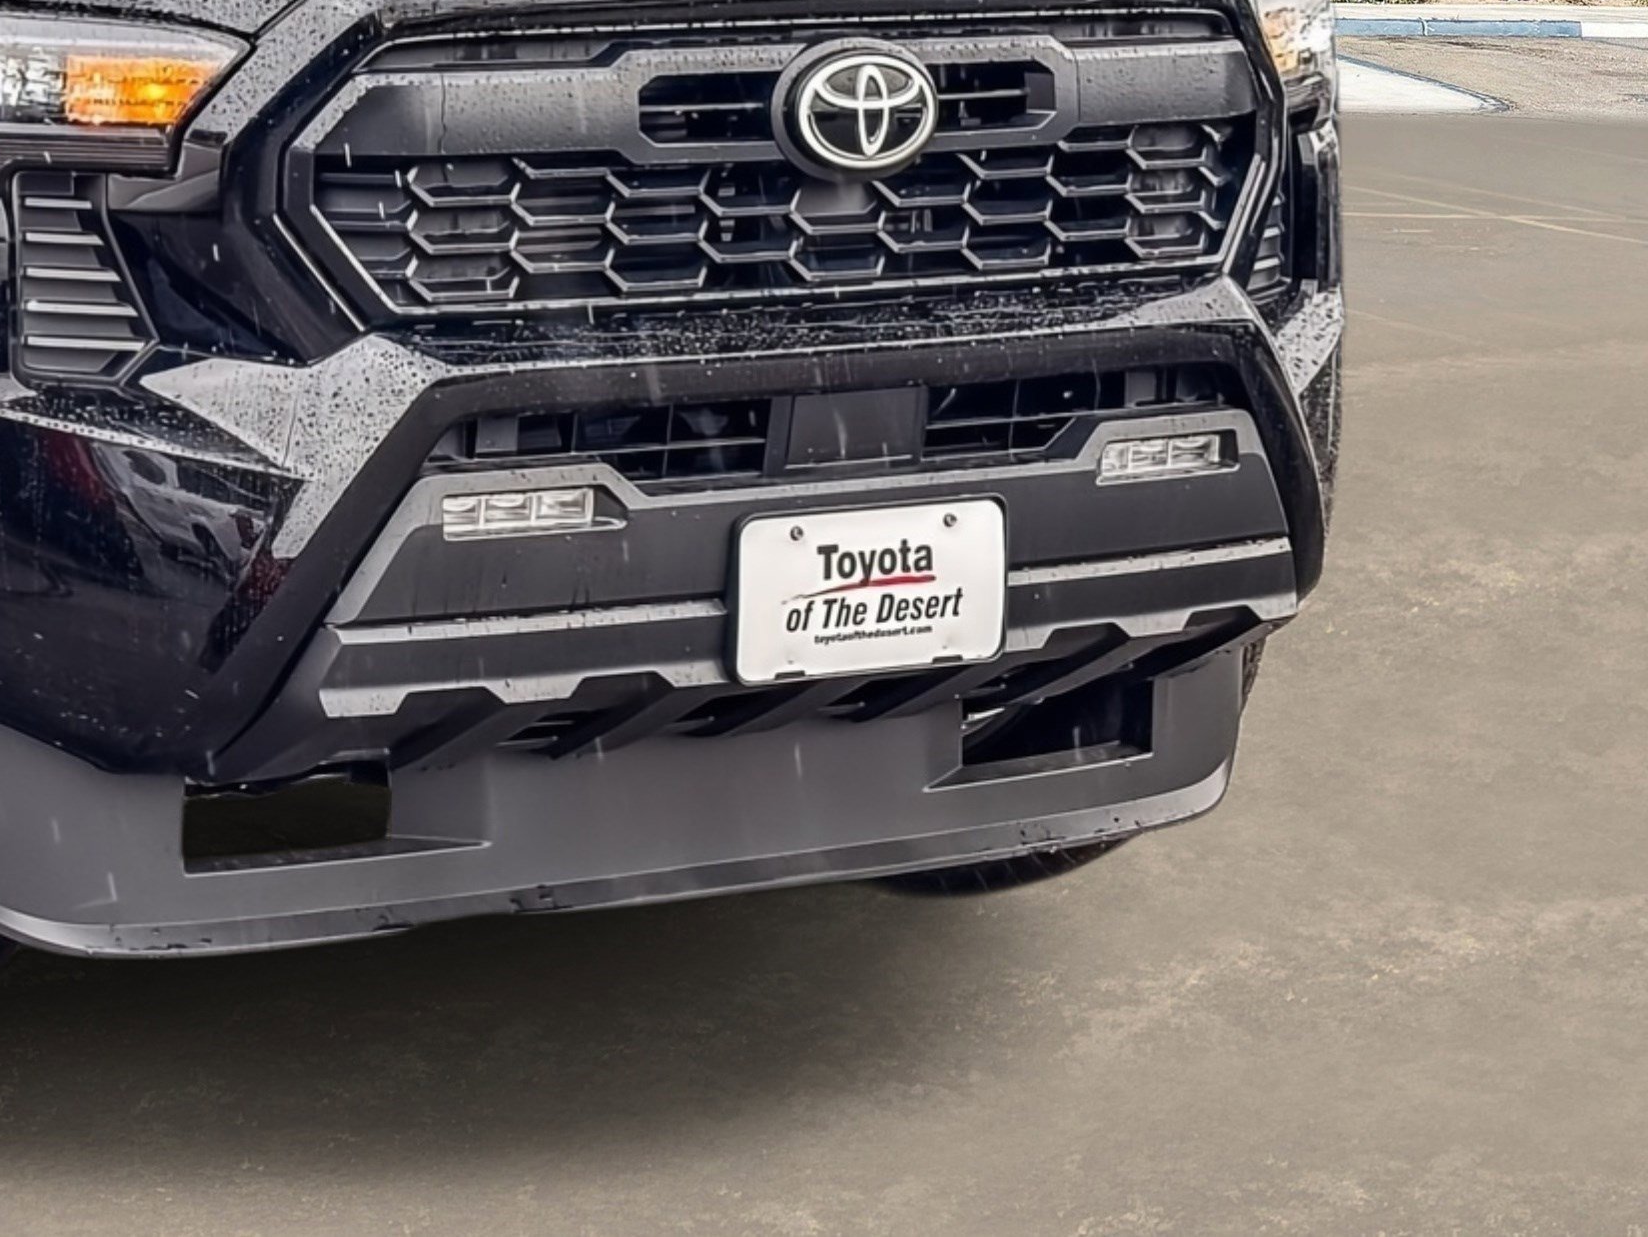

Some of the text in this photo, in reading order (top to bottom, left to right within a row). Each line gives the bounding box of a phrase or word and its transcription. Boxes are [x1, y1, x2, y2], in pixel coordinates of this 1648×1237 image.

[816, 539, 934, 586] Toyota
[786, 587, 964, 633] of The Desert
